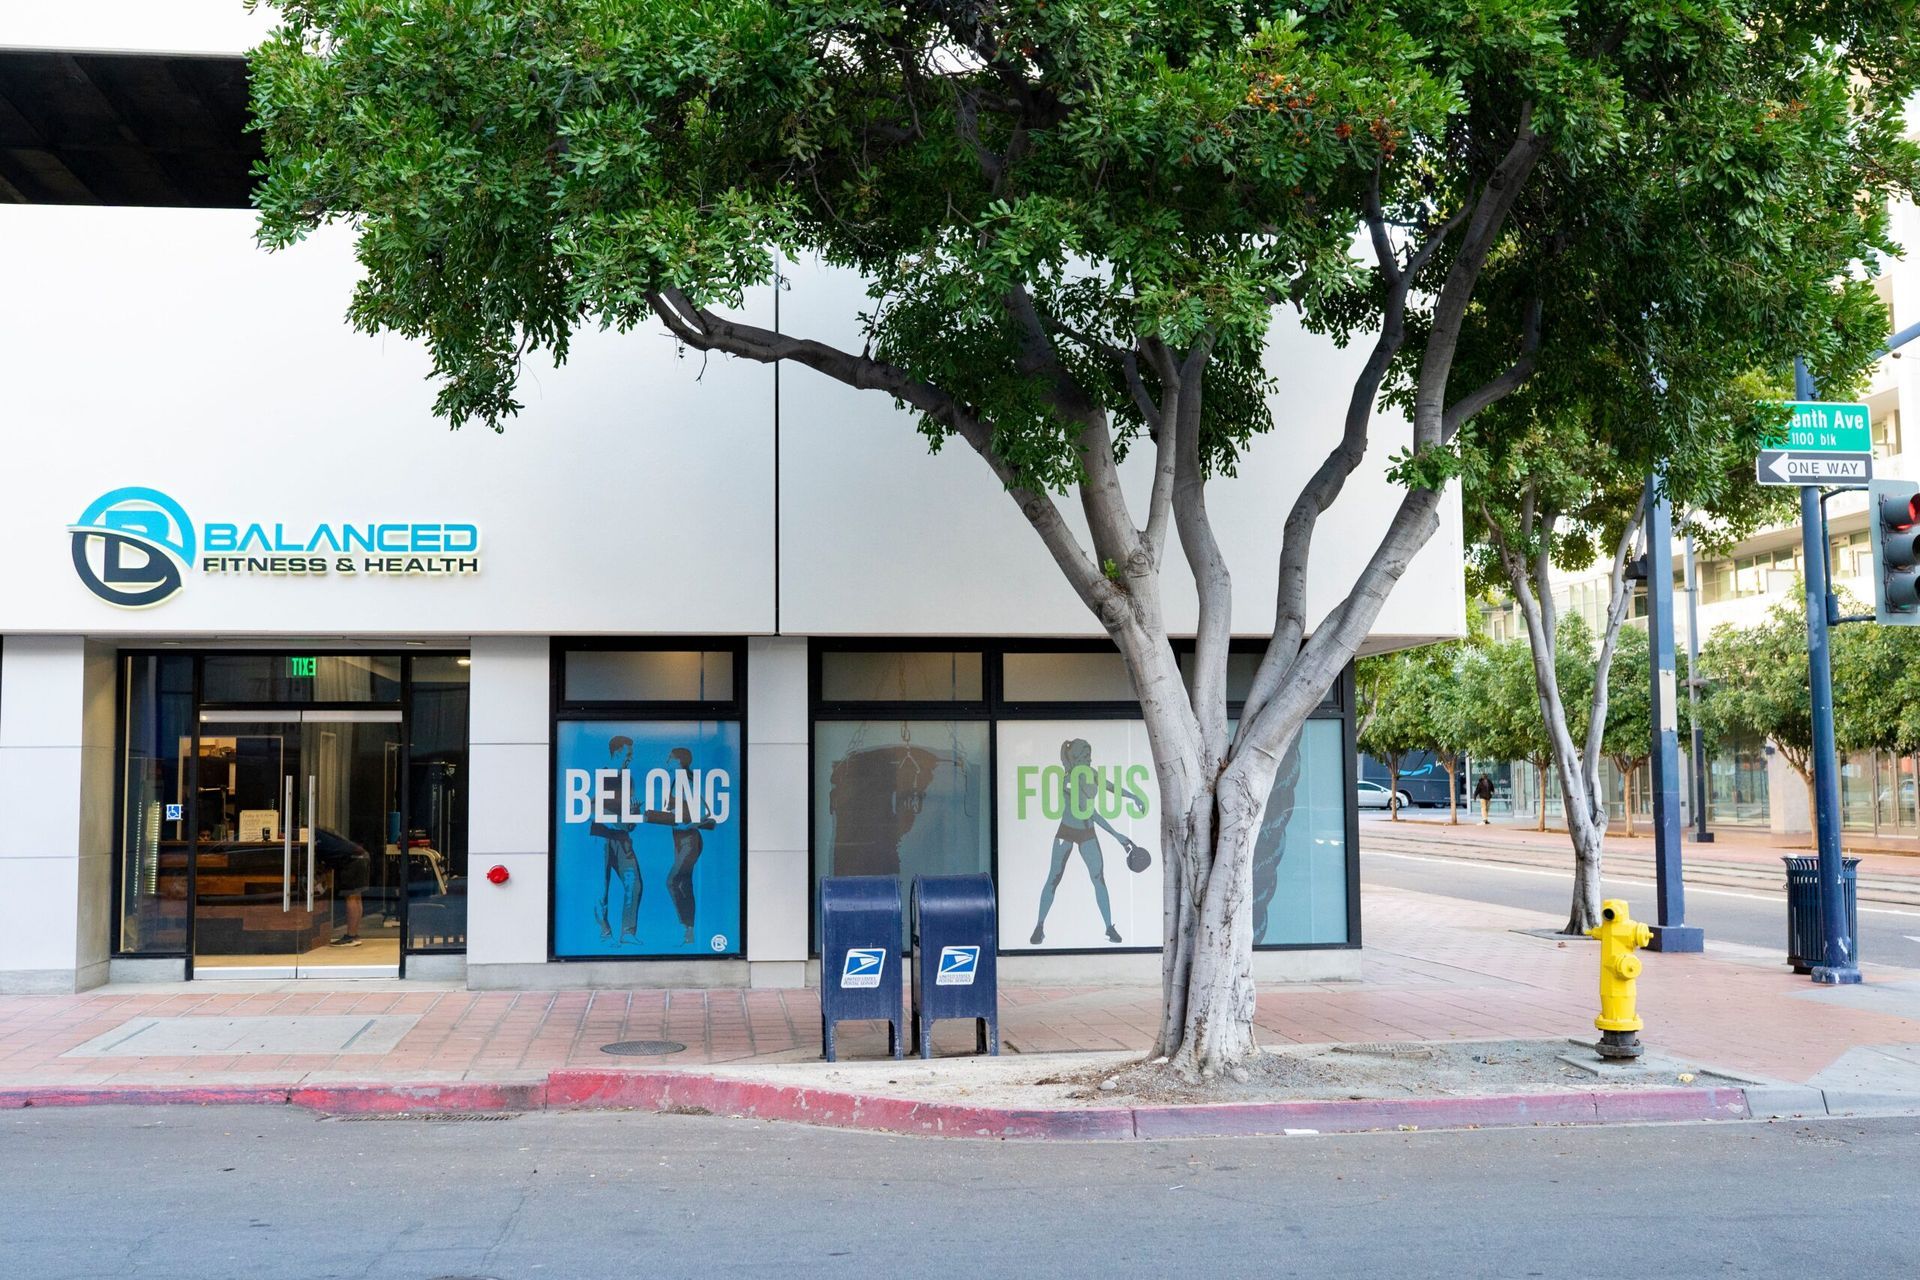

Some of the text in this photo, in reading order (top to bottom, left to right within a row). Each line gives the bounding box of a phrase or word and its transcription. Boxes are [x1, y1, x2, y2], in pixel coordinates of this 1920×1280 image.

[1785, 409, 1864, 429] enth Ave
[1791, 432, 1837, 446] 1100 blk
[1787, 461, 1858, 475] ONE WAY
[204, 523, 478, 552] BALANCED
[202, 557, 478, 572] FITNESS & HEALTH
[565, 768, 730, 824] BELONG
[1017, 764, 1150, 820] FOCUS
